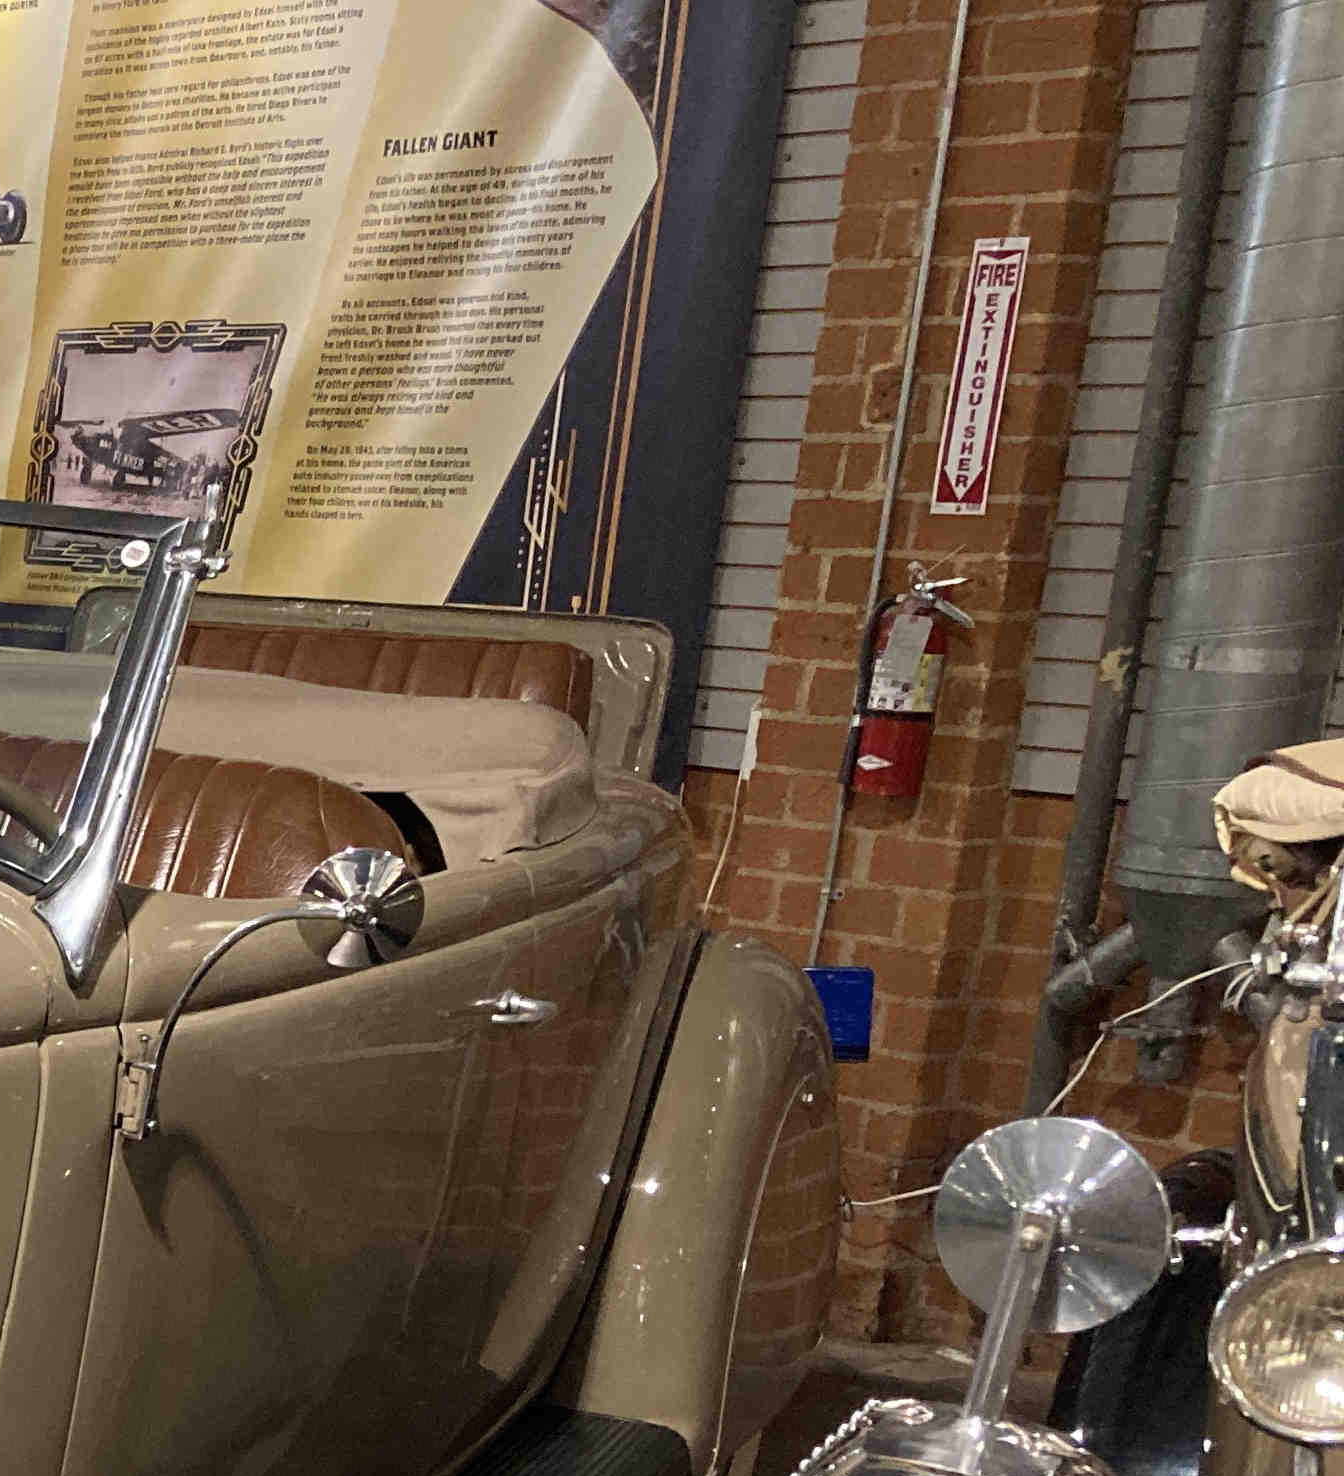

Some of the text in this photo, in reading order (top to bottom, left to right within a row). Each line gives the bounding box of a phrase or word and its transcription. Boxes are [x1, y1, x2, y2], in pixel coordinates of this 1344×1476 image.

[383, 130, 498, 158] FALLEN GIANT
[976, 264, 1018, 287] FIRE
[954, 292, 1002, 489] EXTINGUISHER
